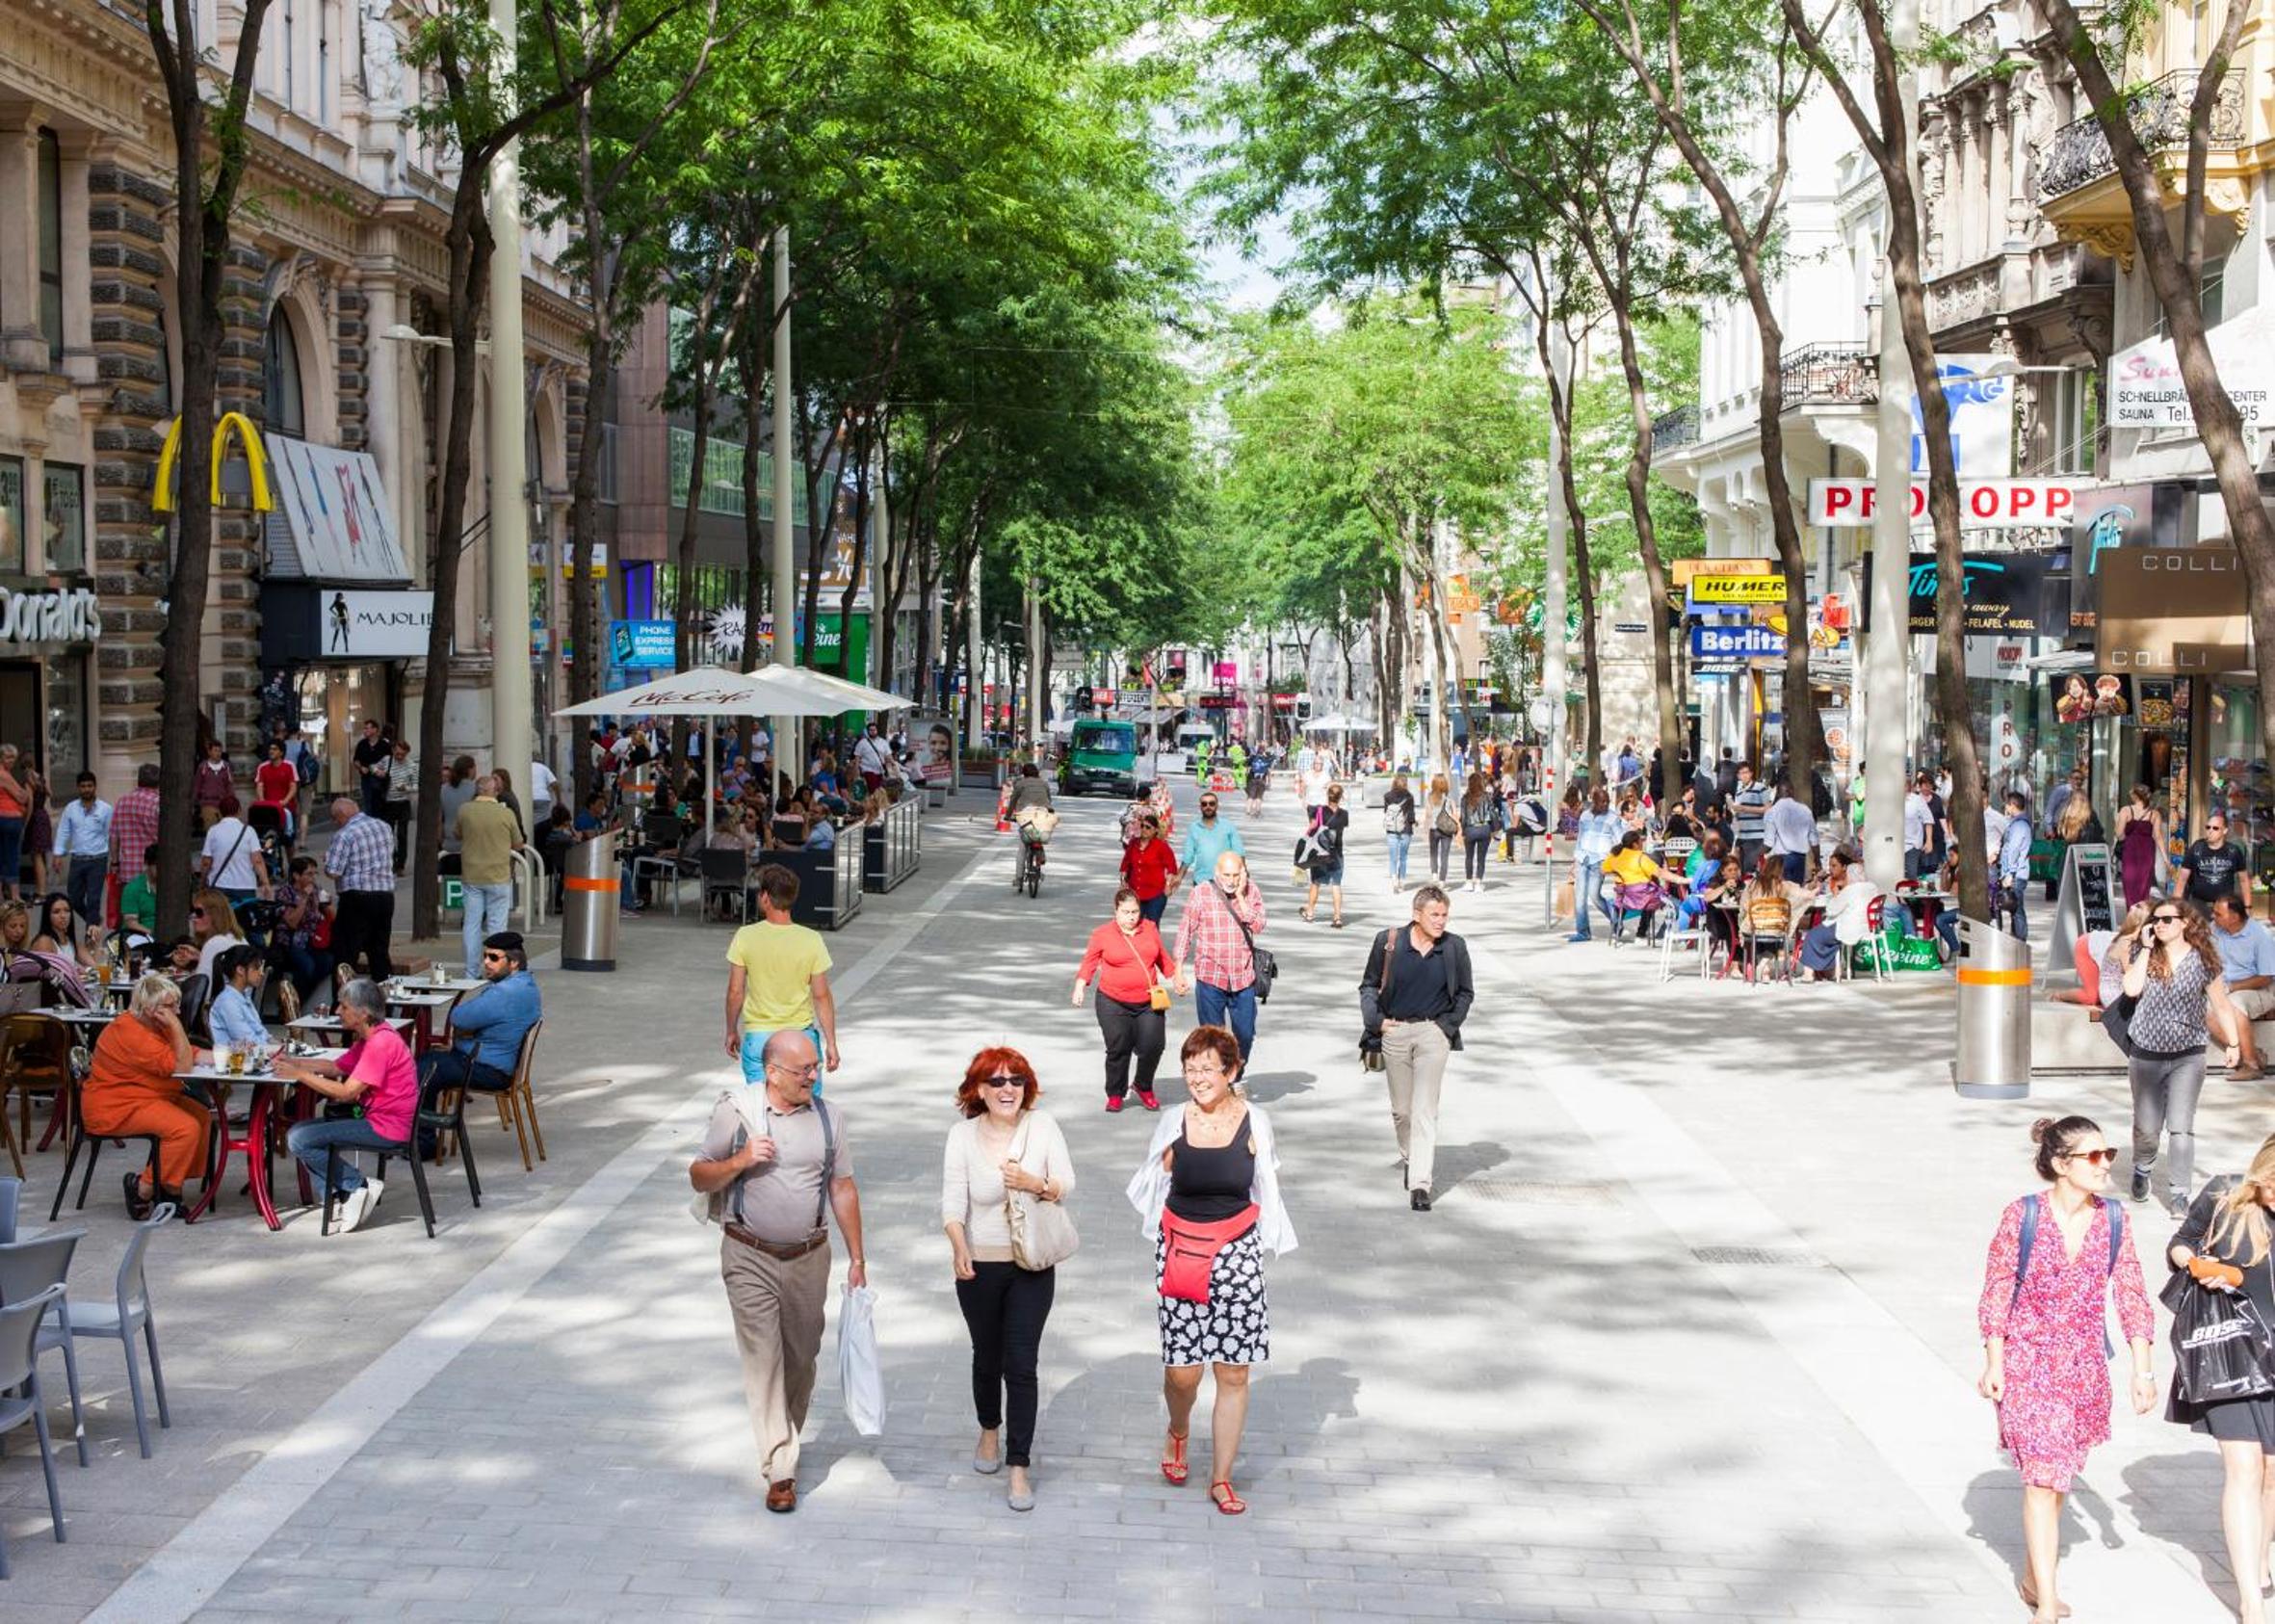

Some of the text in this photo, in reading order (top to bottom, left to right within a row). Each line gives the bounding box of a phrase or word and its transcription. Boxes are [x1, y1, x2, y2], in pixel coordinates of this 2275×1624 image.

[2118, 408, 2155, 420] SAUNA
[640, 626, 671, 635] PHONE
[1701, 629, 1789, 651] Berlitz
[637, 646, 673, 656] SERVICE
[2112, 651, 2207, 667] COLLI
